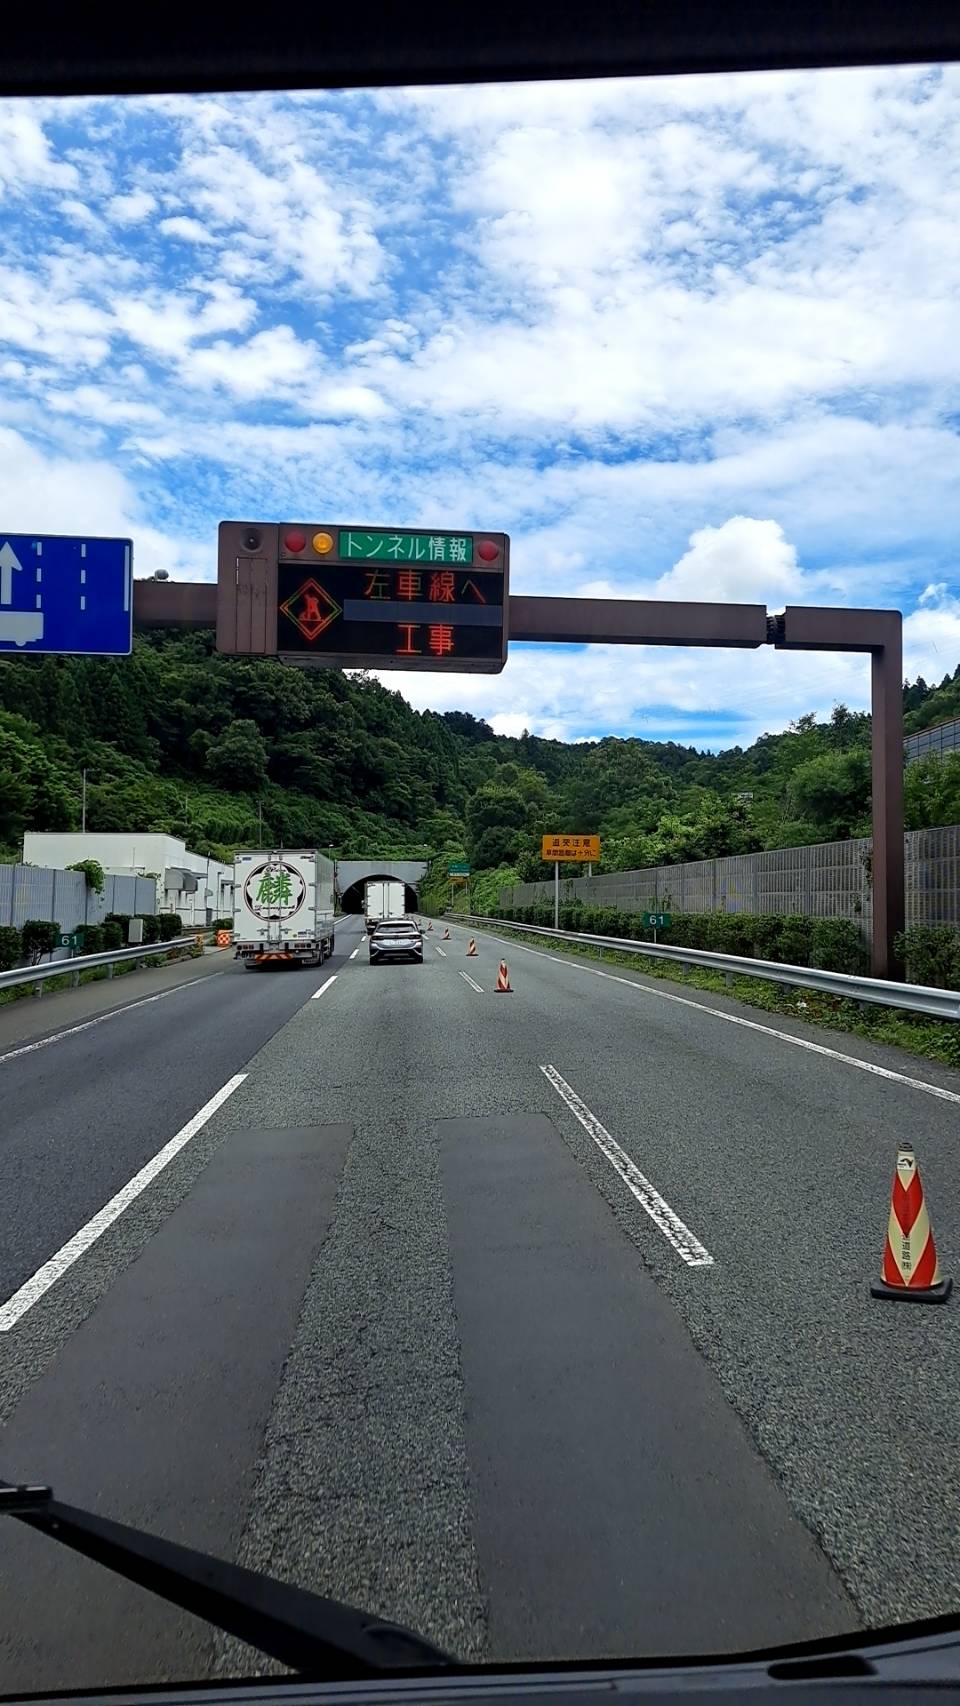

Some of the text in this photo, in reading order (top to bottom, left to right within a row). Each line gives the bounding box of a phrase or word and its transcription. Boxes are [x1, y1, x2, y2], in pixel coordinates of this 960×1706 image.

[346, 534, 468, 562] トンネル情報
[364, 569, 487, 604] 左車線へ
[396, 623, 455, 656] 工事
[649, 915, 664, 925] 61
[61, 935, 77, 946] 61
